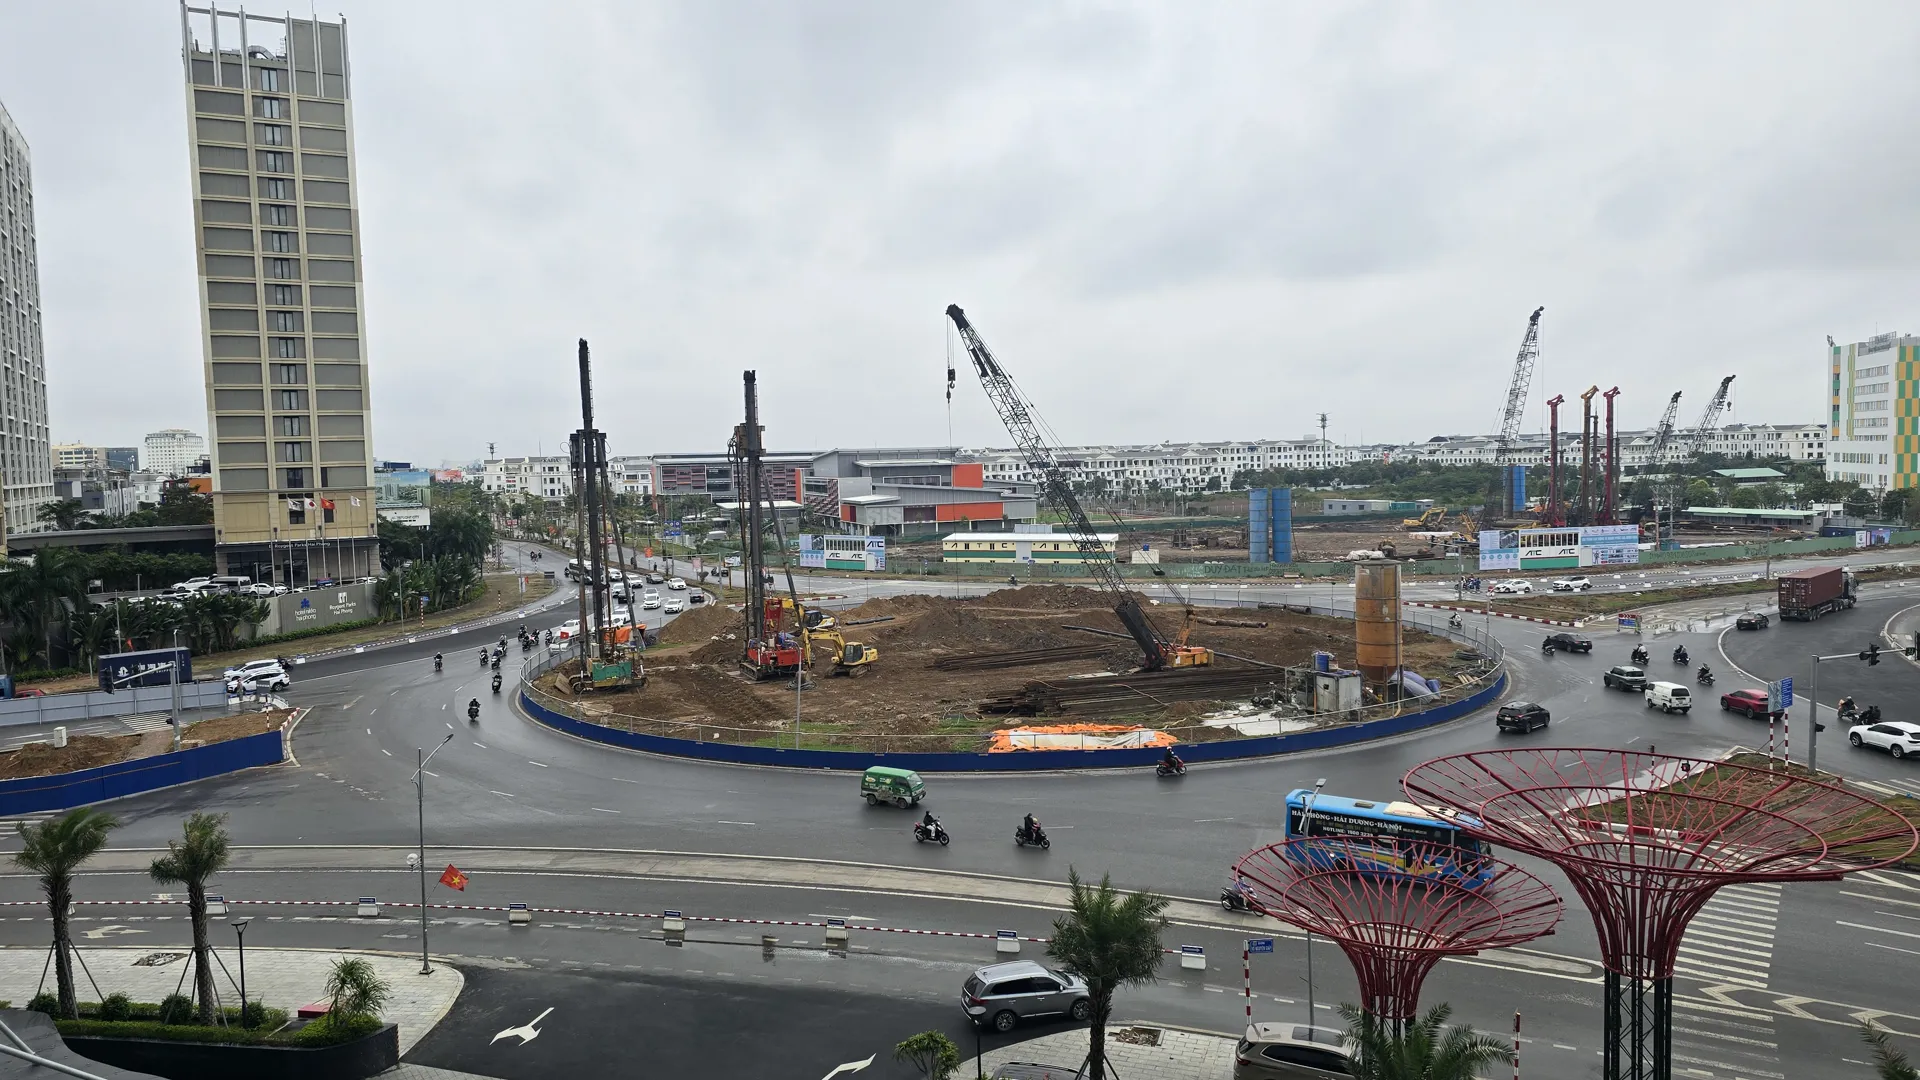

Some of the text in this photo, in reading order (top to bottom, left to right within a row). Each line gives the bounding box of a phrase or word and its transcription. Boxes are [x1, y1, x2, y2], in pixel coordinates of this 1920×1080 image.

[866, 507, 902, 524] SIS
[866, 540, 884, 548] ATC
[1525, 549, 1542, 557] ATC
